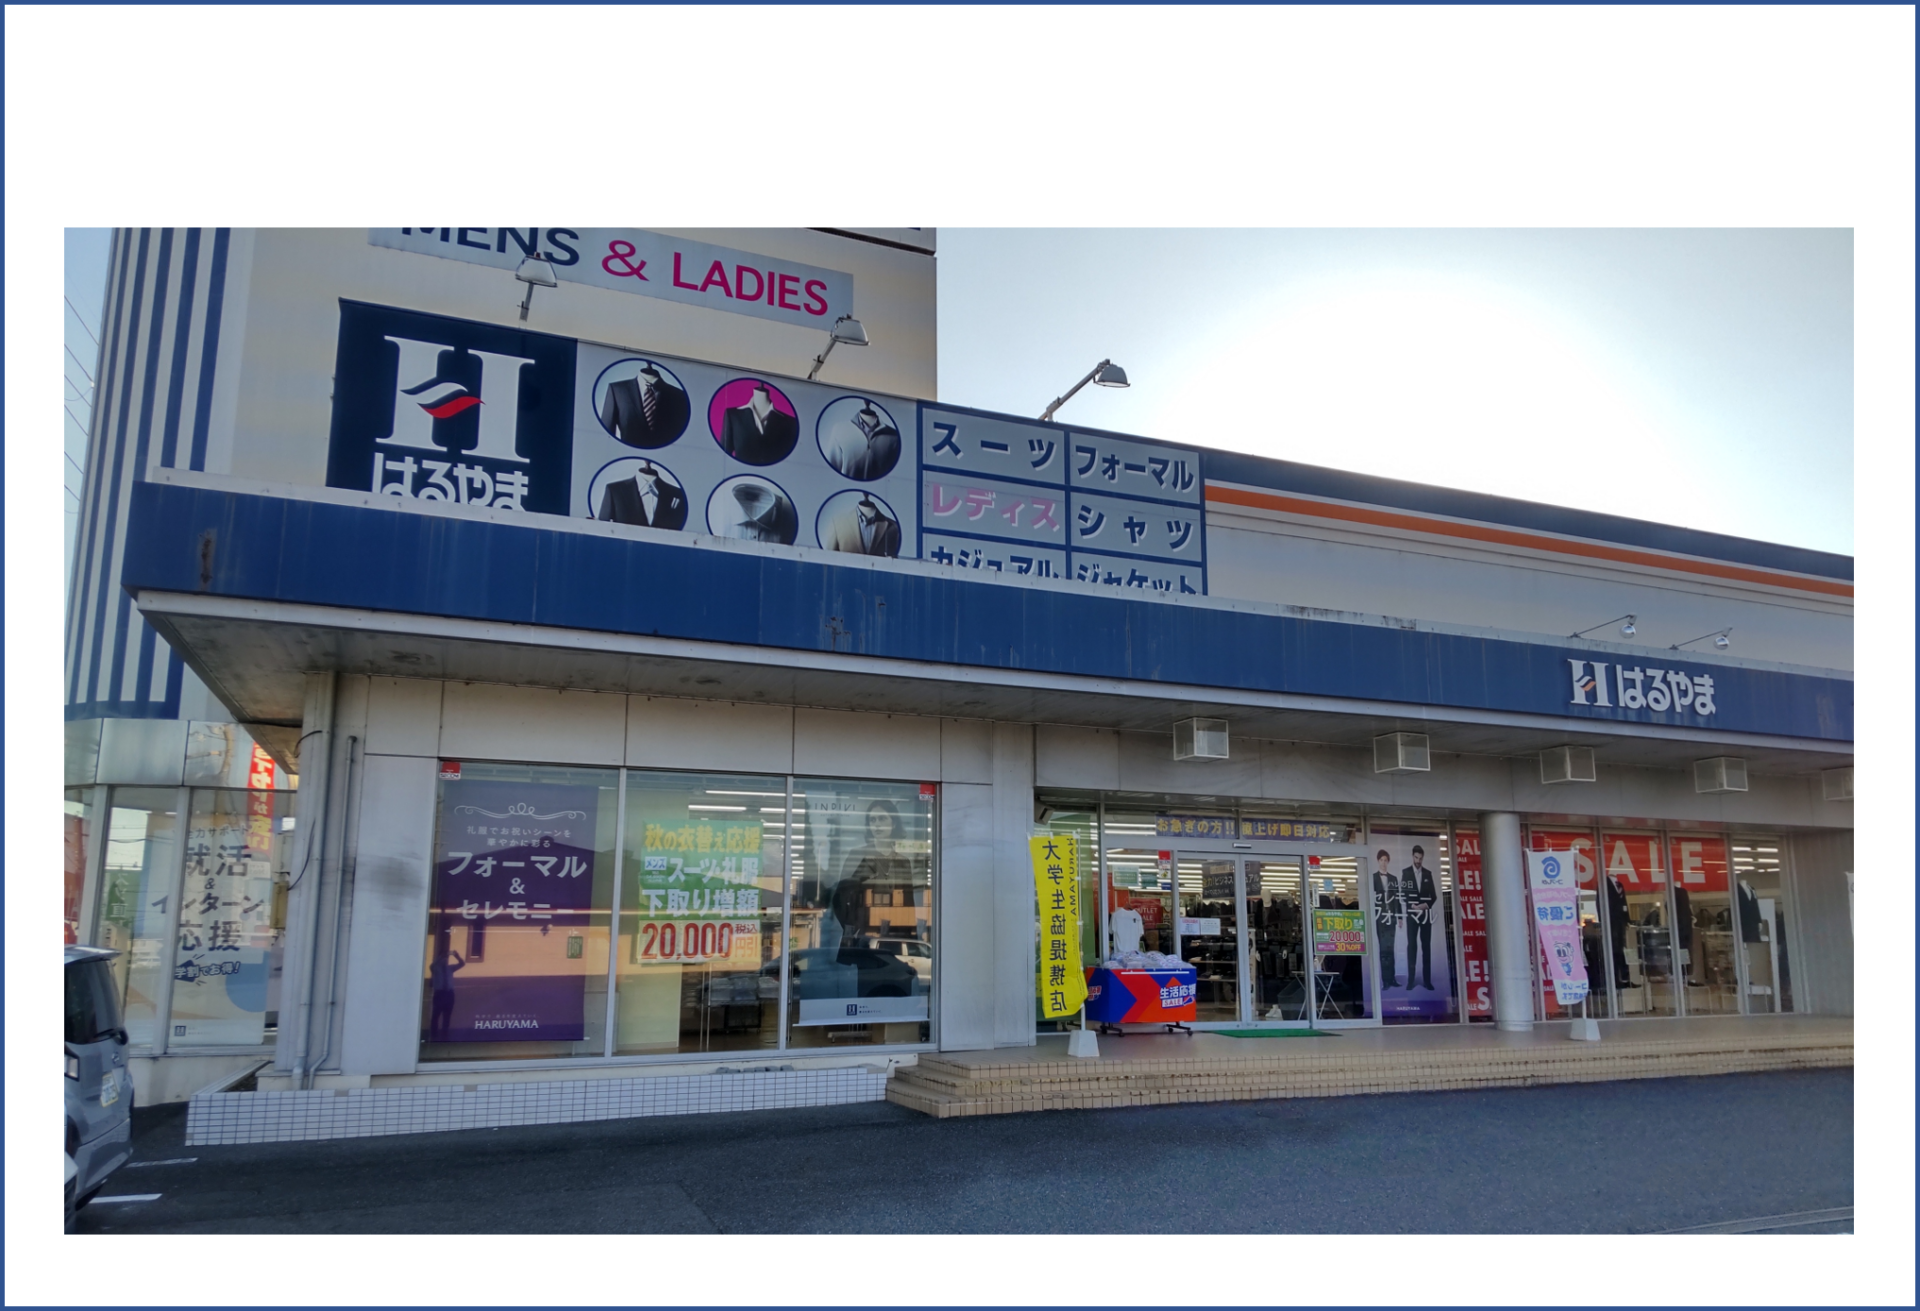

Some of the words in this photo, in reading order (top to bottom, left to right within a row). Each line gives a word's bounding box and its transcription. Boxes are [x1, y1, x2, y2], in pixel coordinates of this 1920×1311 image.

[402, 227, 580, 266] ENS
[601, 239, 648, 282] &
[672, 252, 829, 315] LADIES
[932, 421, 1057, 471] スーツ
[1075, 445, 1196, 493] フォーマル
[371, 452, 529, 512] はるやま
[932, 482, 1061, 532] レディス
[1077, 505, 1194, 551] シャツ
[1616, 664, 1716, 716] はるやま
[814, 803, 856, 812] INDIVI
[466, 825, 572, 838] 礼服でお祝いシーンを
[644, 824, 760, 854] 秋の衣替え応援
[487, 838, 551, 848] 華やかに彩る
[447, 851, 588, 878] フォーマル
[645, 857, 667, 869] メンズ
[1570, 837, 1706, 884] SALE
[204, 877, 216, 890] &
[509, 877, 525, 895] &
[1388, 880, 1414, 889] ハレの日
[642, 888, 760, 918] 下取り増額
[1374, 892, 1432, 905] セレモニー
[456, 899, 575, 920] セレモニー
[1374, 906, 1439, 926] フォーマル
[735, 923, 758, 934] 税込
[1323, 917, 1353, 930] 下取り
[641, 922, 734, 961] 20,000
[734, 936, 759, 958] 円引
[1164, 998, 1183, 1008] SALE
[474, 1019, 539, 1030] HARUYAMA
